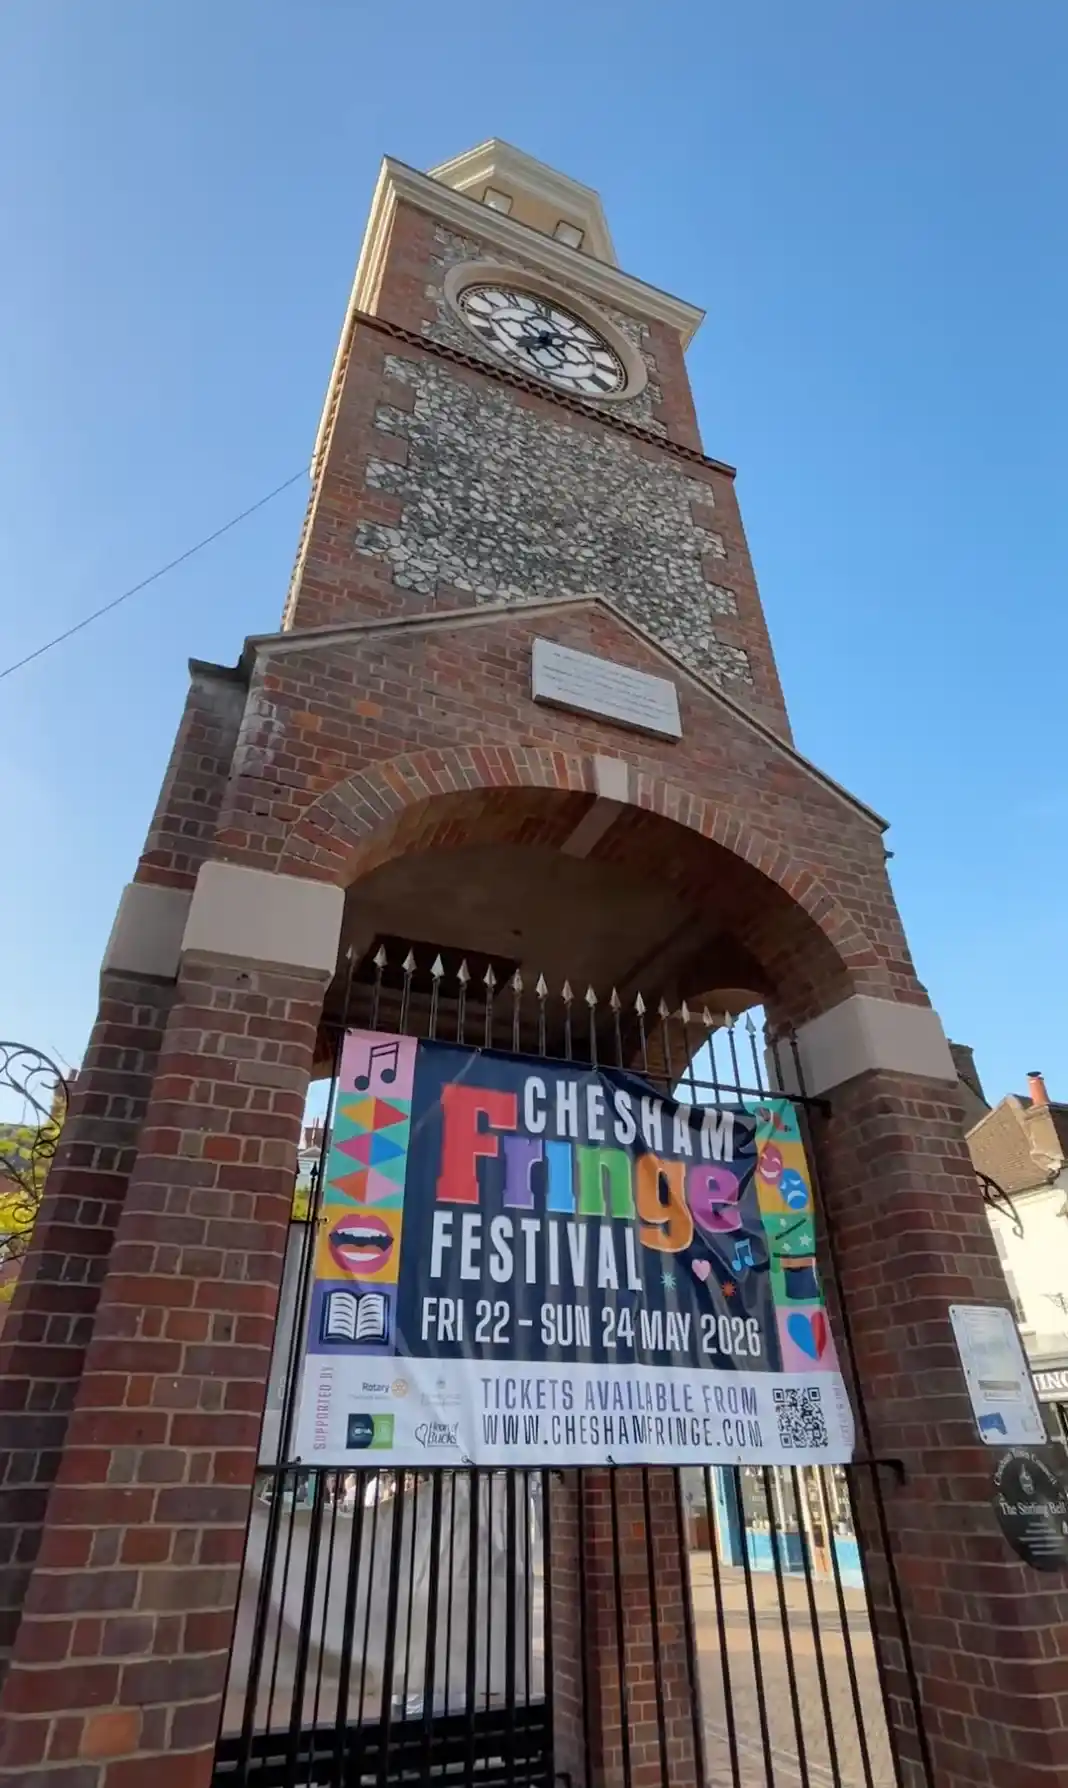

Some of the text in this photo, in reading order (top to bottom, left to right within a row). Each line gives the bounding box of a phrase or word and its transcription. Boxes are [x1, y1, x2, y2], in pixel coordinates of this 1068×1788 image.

[524, 1076, 736, 1164] CHESHAM
[435, 1083, 743, 1254] Fringe
[429, 1210, 644, 1292] FESTIVAL
[421, 1297, 463, 1343] FRI
[475, 1300, 511, 1345] 22
[540, 1304, 591, 1348] SUN
[602, 1308, 634, 1349] 24
[641, 1311, 692, 1353] MAY
[702, 1313, 762, 1357] 2026
[313, 1384, 332, 1450] SUPPORTED
[362, 1382, 390, 1394] Rotary
[481, 1378, 758, 1417] TICKETS AVAILABLE FROM
[482, 1414, 763, 1447] WWW.CHESHAMFRINGE.COM
